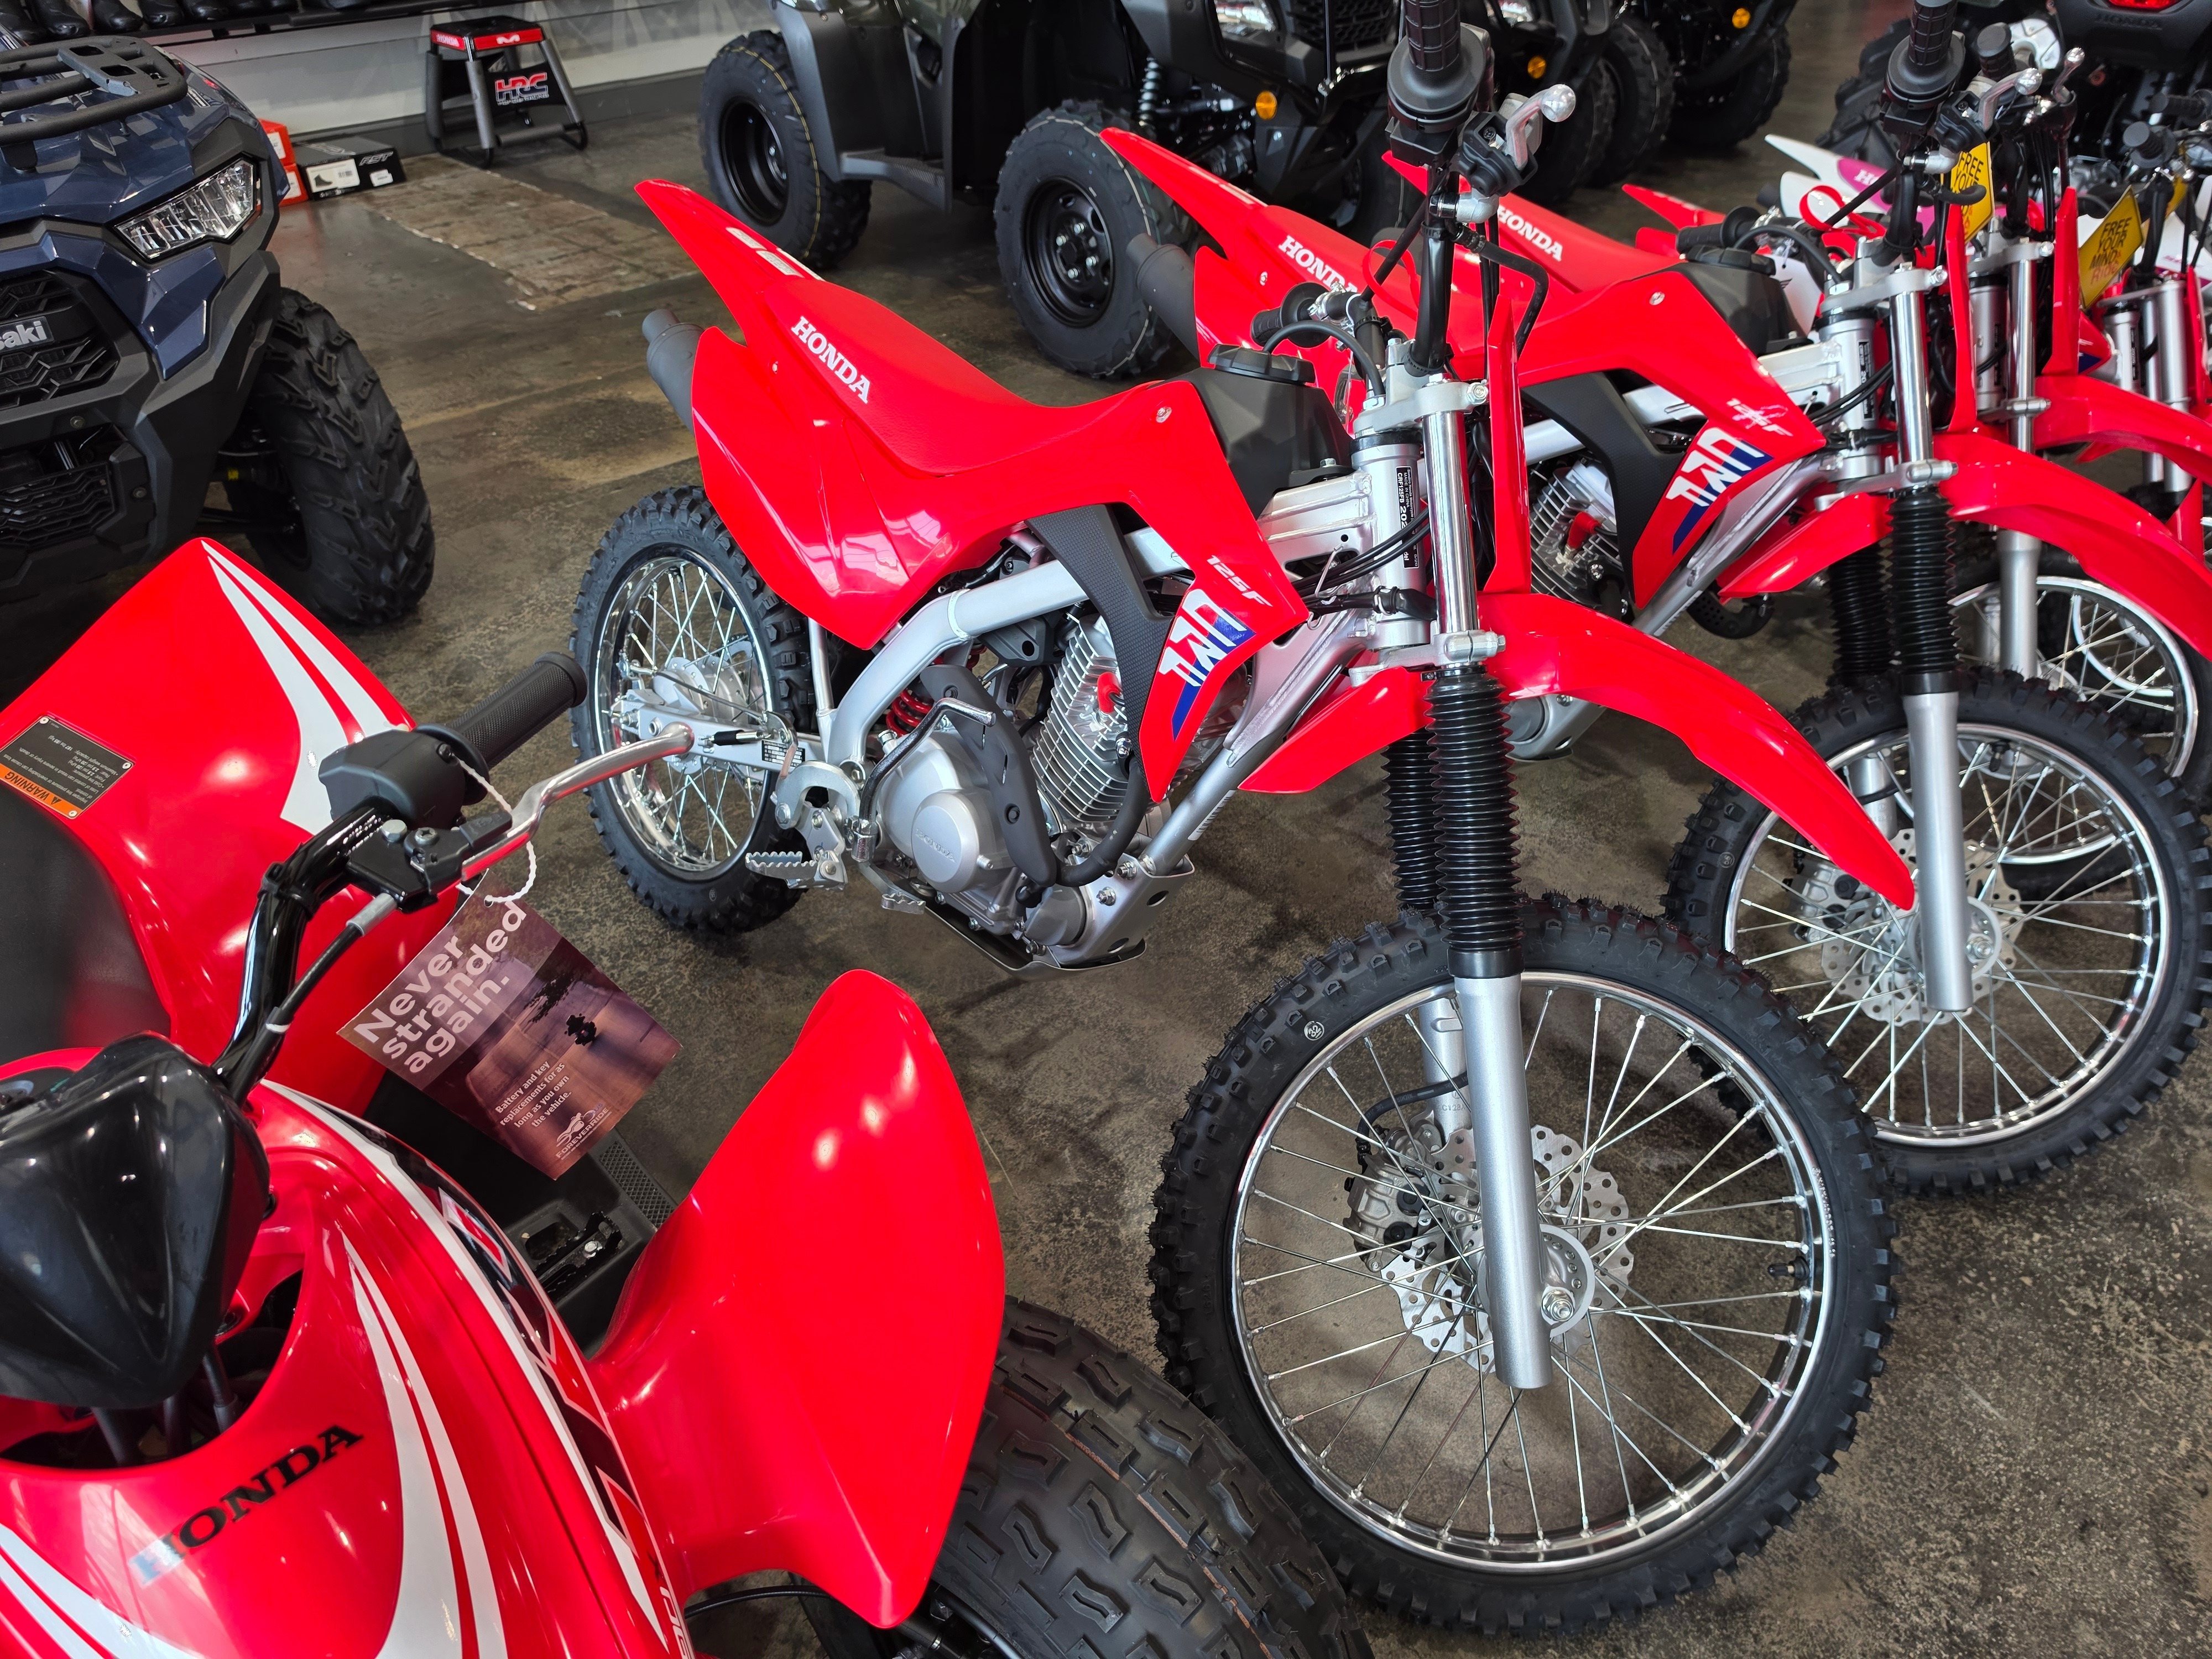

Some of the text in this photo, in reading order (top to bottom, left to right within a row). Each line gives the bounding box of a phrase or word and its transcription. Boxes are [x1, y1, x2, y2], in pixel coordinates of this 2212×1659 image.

[1954, 168, 1978, 191] YOU
[1958, 152, 1984, 181] FREE
[1497, 205, 1563, 262] HONDA
[2098, 230, 2127, 253] YOUR
[2101, 216, 2132, 238] FREE
[2089, 249, 2117, 270] MIND
[791, 316, 870, 404] HONDA
[1396, 472, 1405, 503] CRF125FB
[1399, 505, 1407, 528] 202
[1207, 555, 1273, 607] 125F
[27, 767, 49, 781] overloading
[32, 755, 45, 763] injury
[5, 771, 50, 801] WARNING
[50, 780, 68, 791] pressure
[73, 778, 87, 786] control
[916, 828, 955, 863] HONDA
[354, 935, 463, 1043] Never
[383, 900, 527, 1058] stranded
[404, 976, 510, 1072] again.
[495, 1061, 550, 1114] Battery and key
[500, 1062, 565, 1126] replacements for as
[514, 1075, 570, 1128] long as you own
[531, 1091, 572, 1128] the vehicle.
[555, 1107, 609, 1159] FOREVERRIDE
[128, 1425, 363, 1588] HONDA
